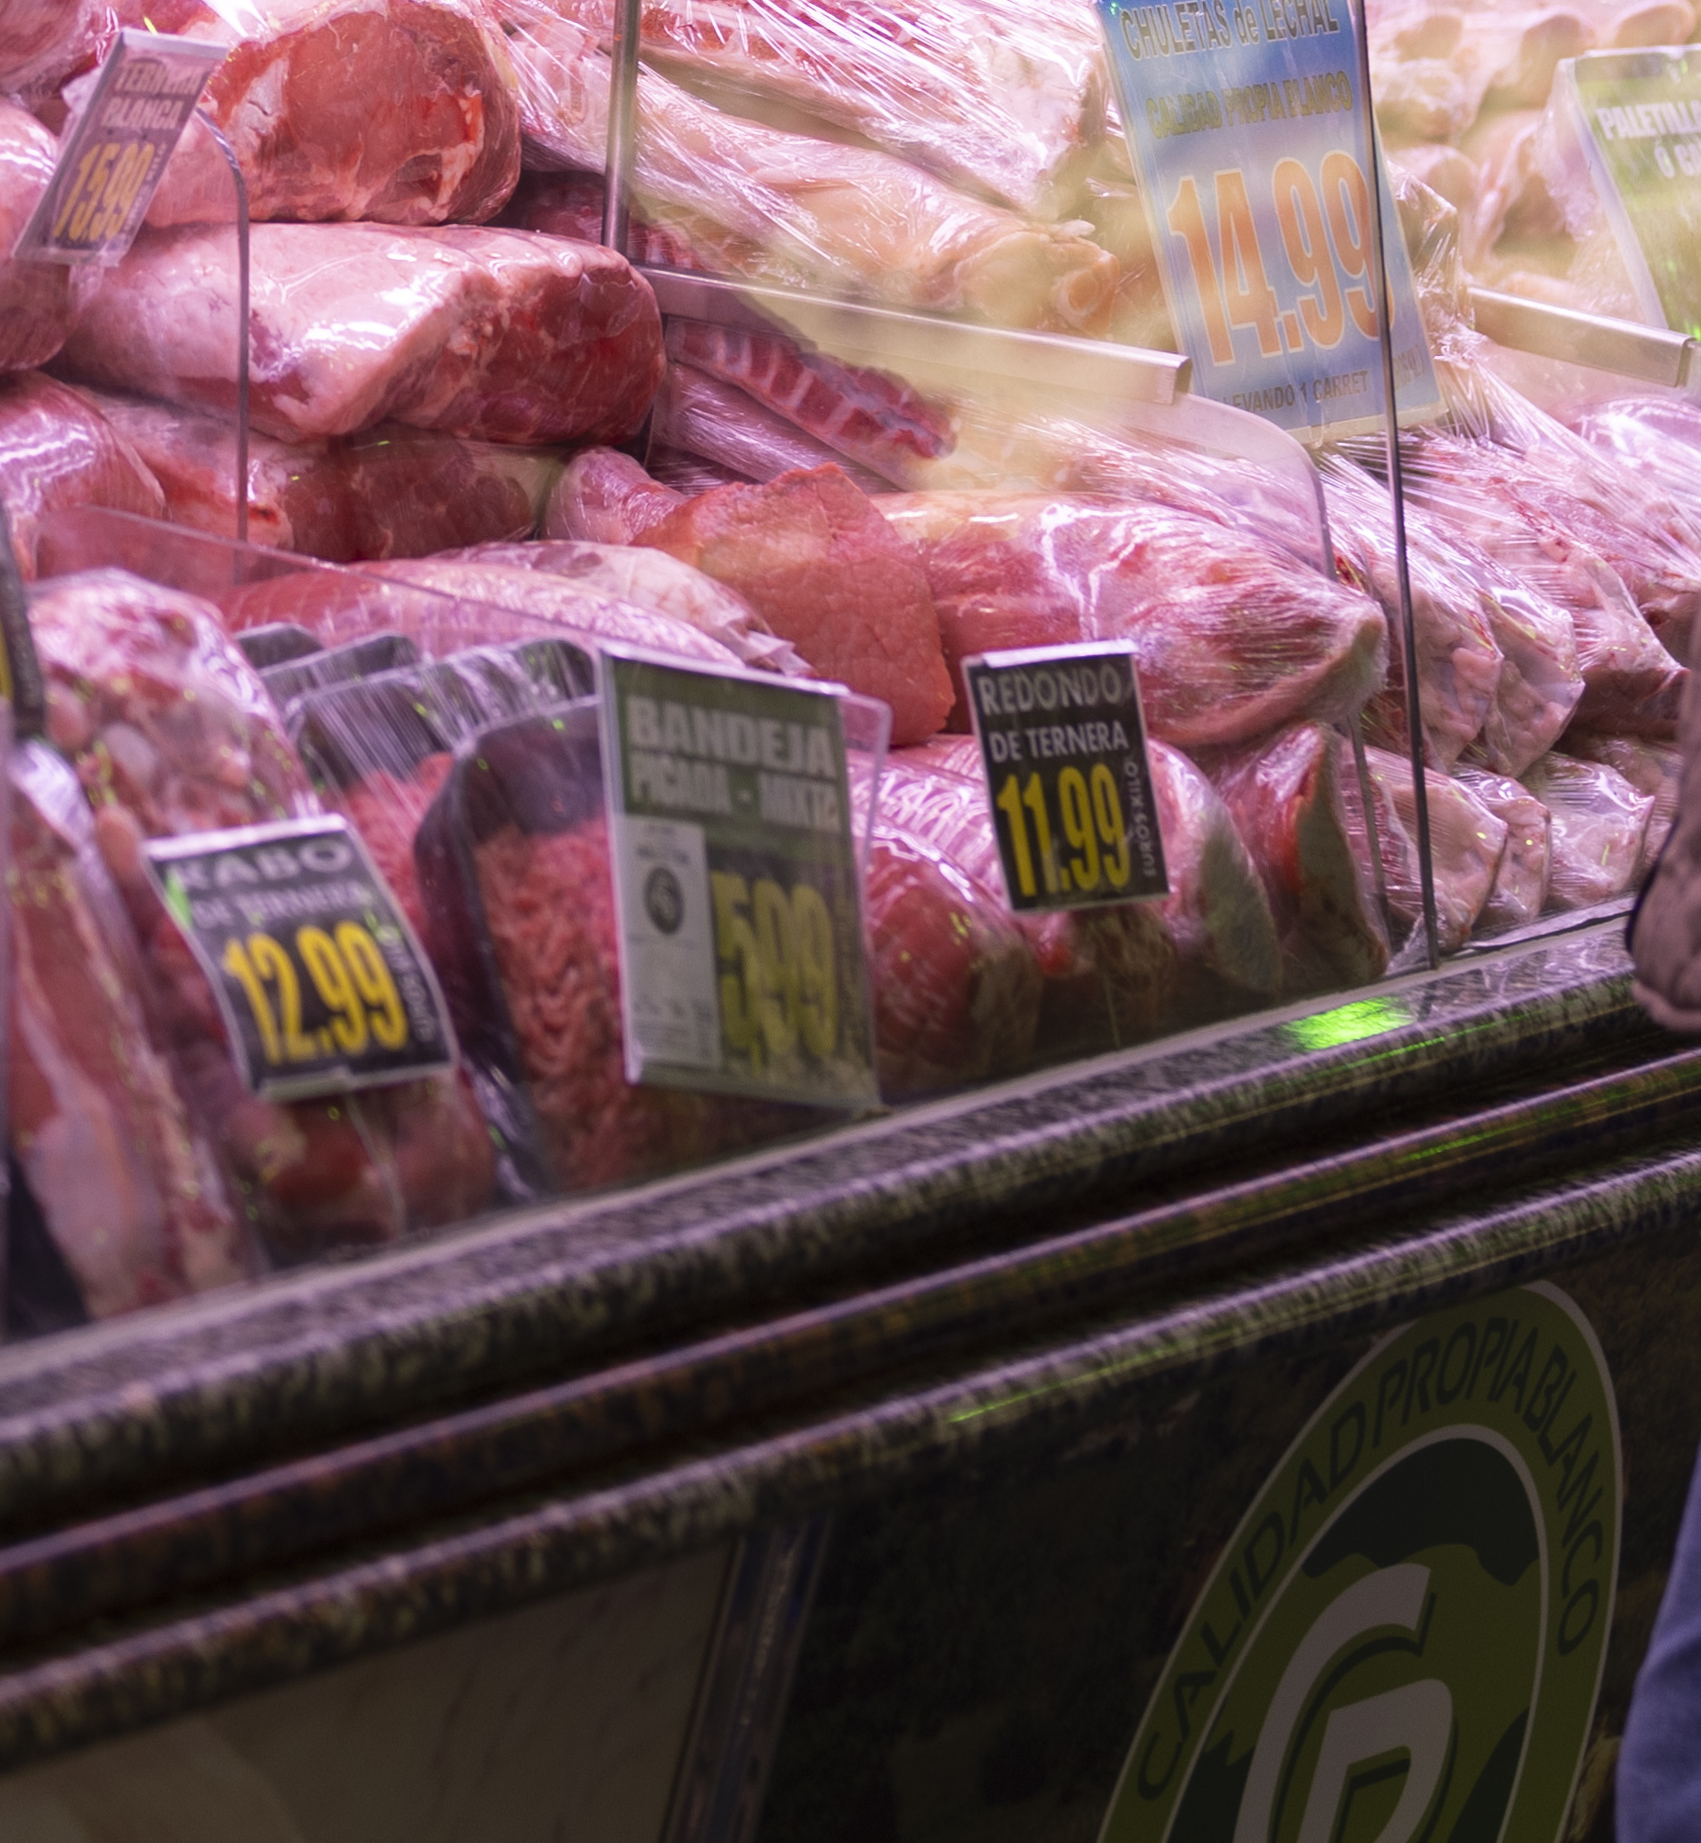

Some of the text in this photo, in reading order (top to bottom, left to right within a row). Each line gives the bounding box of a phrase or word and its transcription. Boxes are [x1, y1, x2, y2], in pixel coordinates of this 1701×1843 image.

[1146, 70, 1354, 140] CALIDAD PROPIA BLANCO
[1167, 150, 1395, 366] 14.99
[626, 694, 839, 778] BANDEJA
[977, 664, 1122, 716] REDONDO
[989, 720, 1129, 764] DE TERNERA
[997, 763, 1131, 897] 11.99
[222, 920, 408, 1065] 12.99
[1136, 1317, 1603, 1801] CALIDAD PROPIA BLANCO
